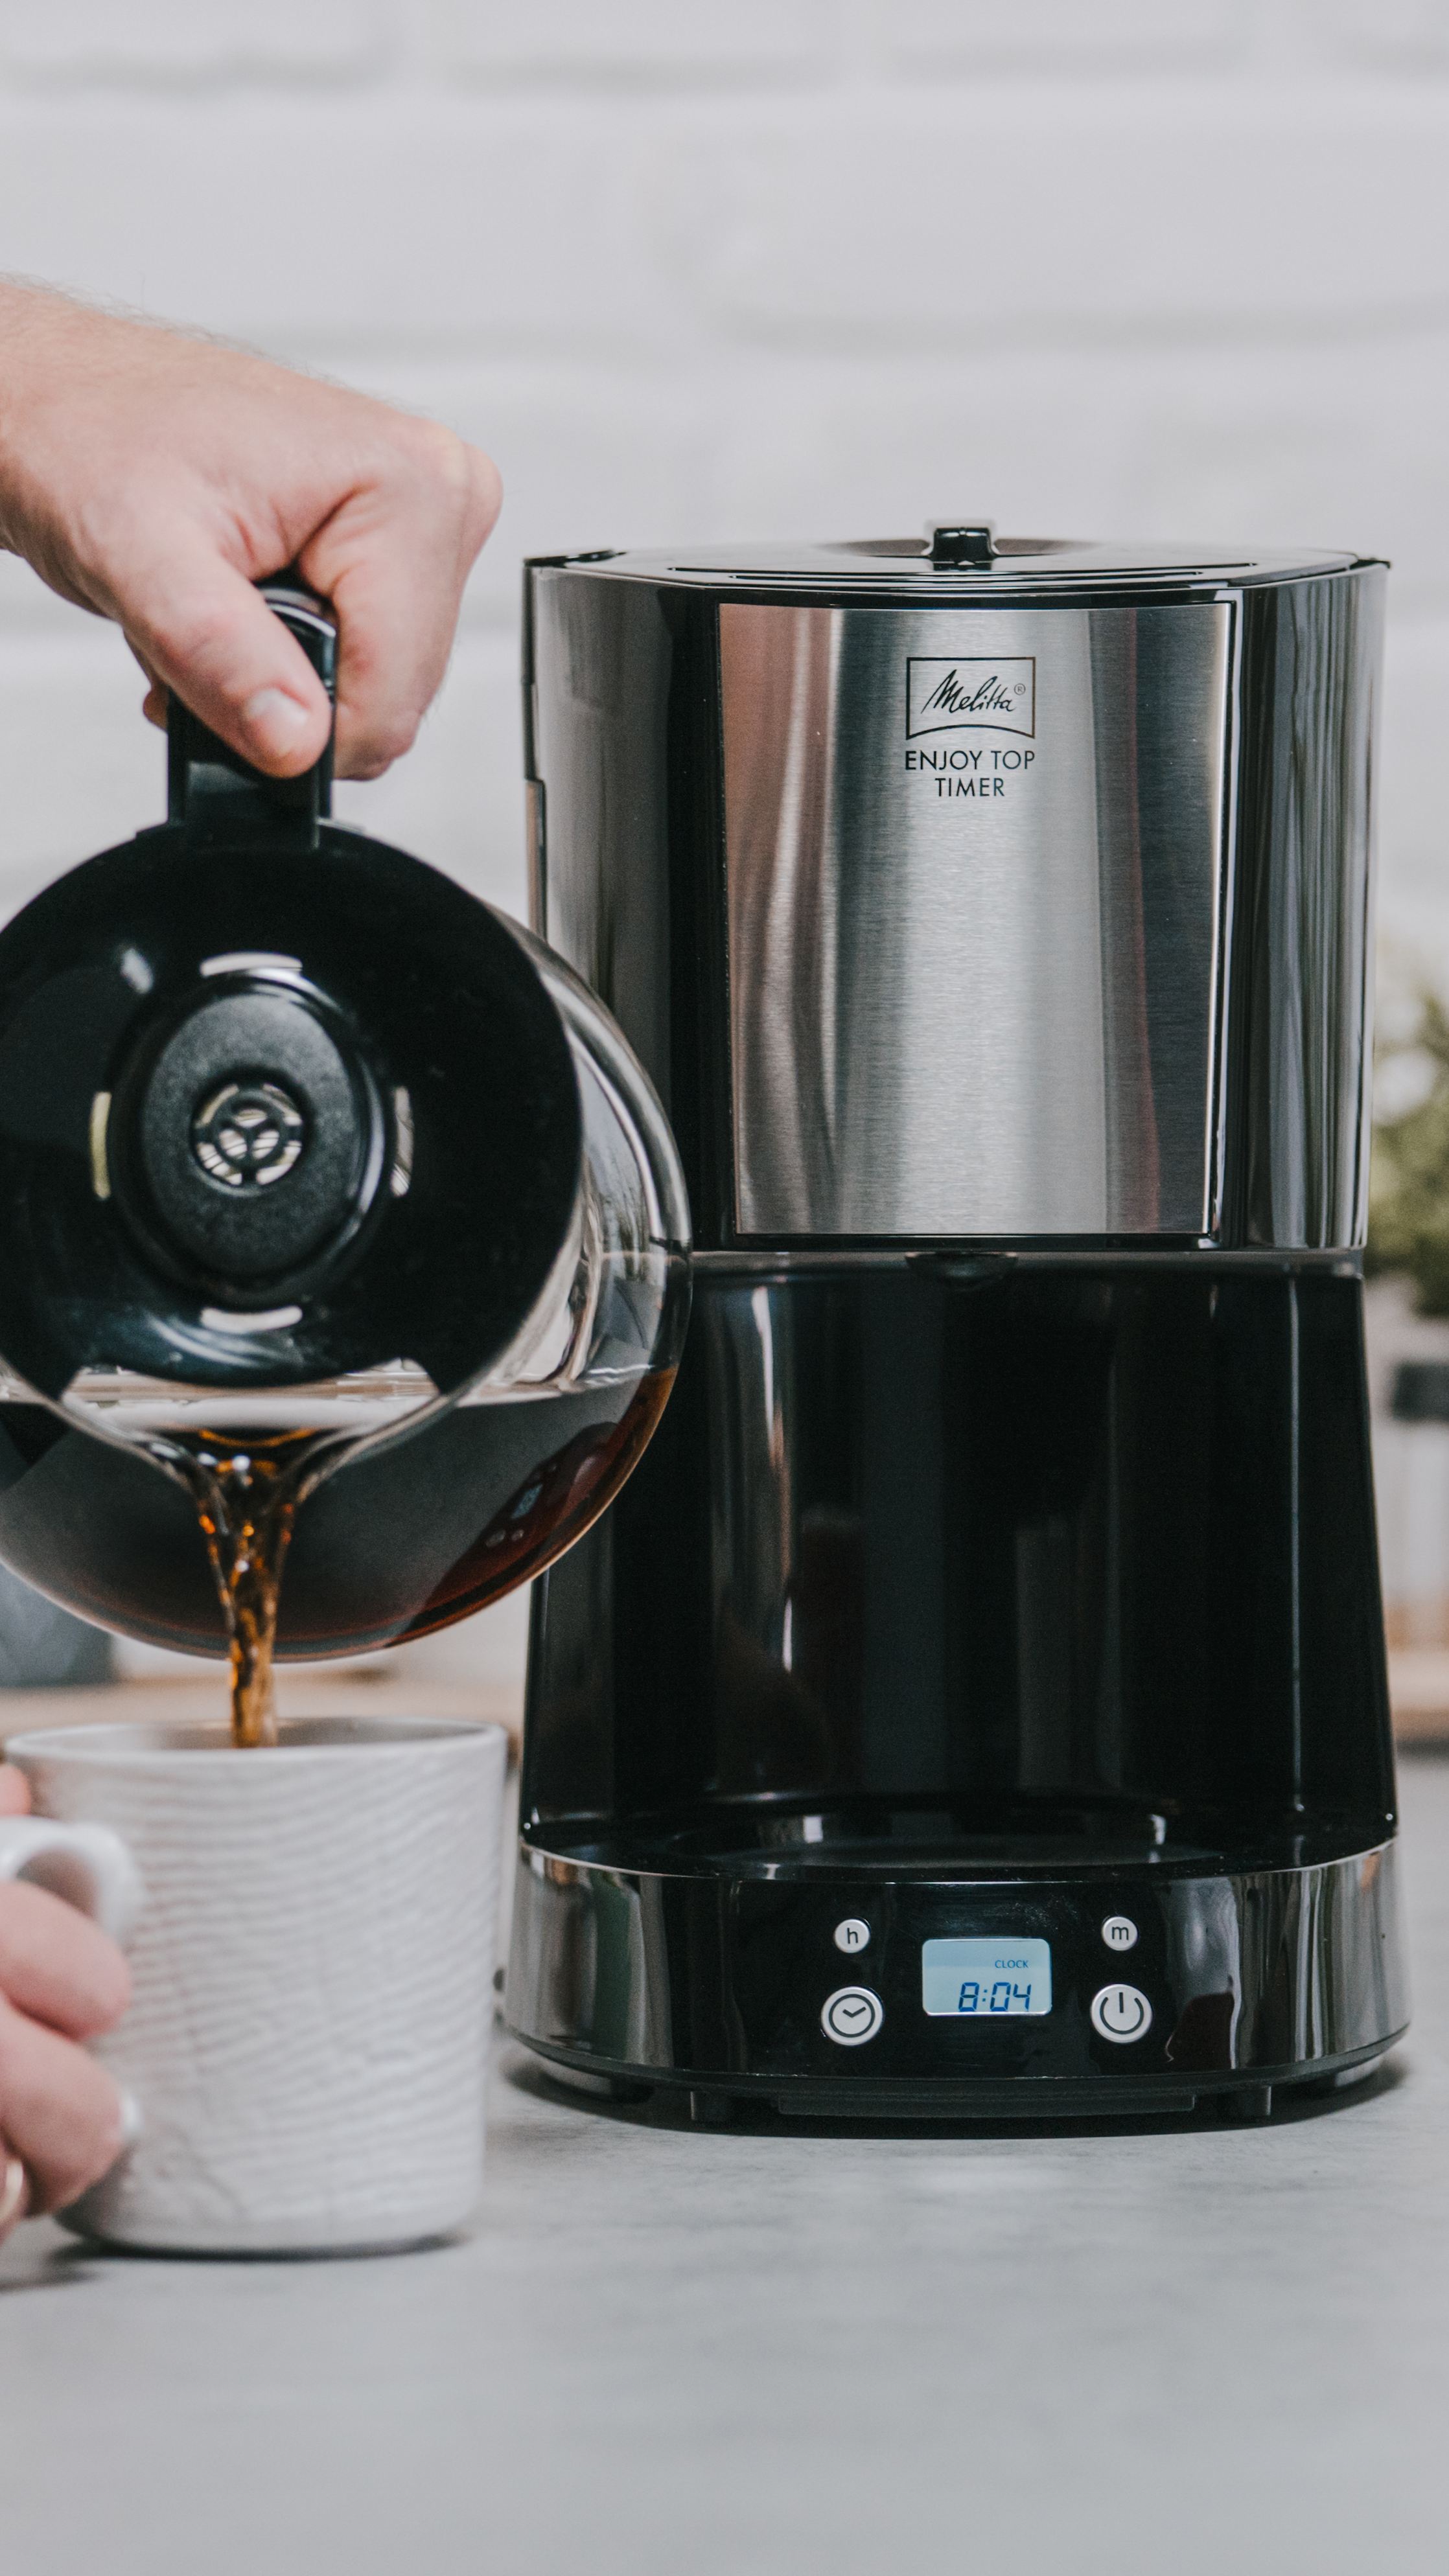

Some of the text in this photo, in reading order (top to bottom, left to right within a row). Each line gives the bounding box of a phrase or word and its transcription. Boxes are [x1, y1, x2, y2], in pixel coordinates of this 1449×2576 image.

[905, 750, 1035, 770] ENJOY TOP
[934, 777, 1004, 797] TIMER
[846, 1927, 859, 1944] h
[1111, 1925, 1130, 1940] m
[994, 1959, 1029, 1969] CLOCK
[958, 1981, 1032, 2012] 8:04
